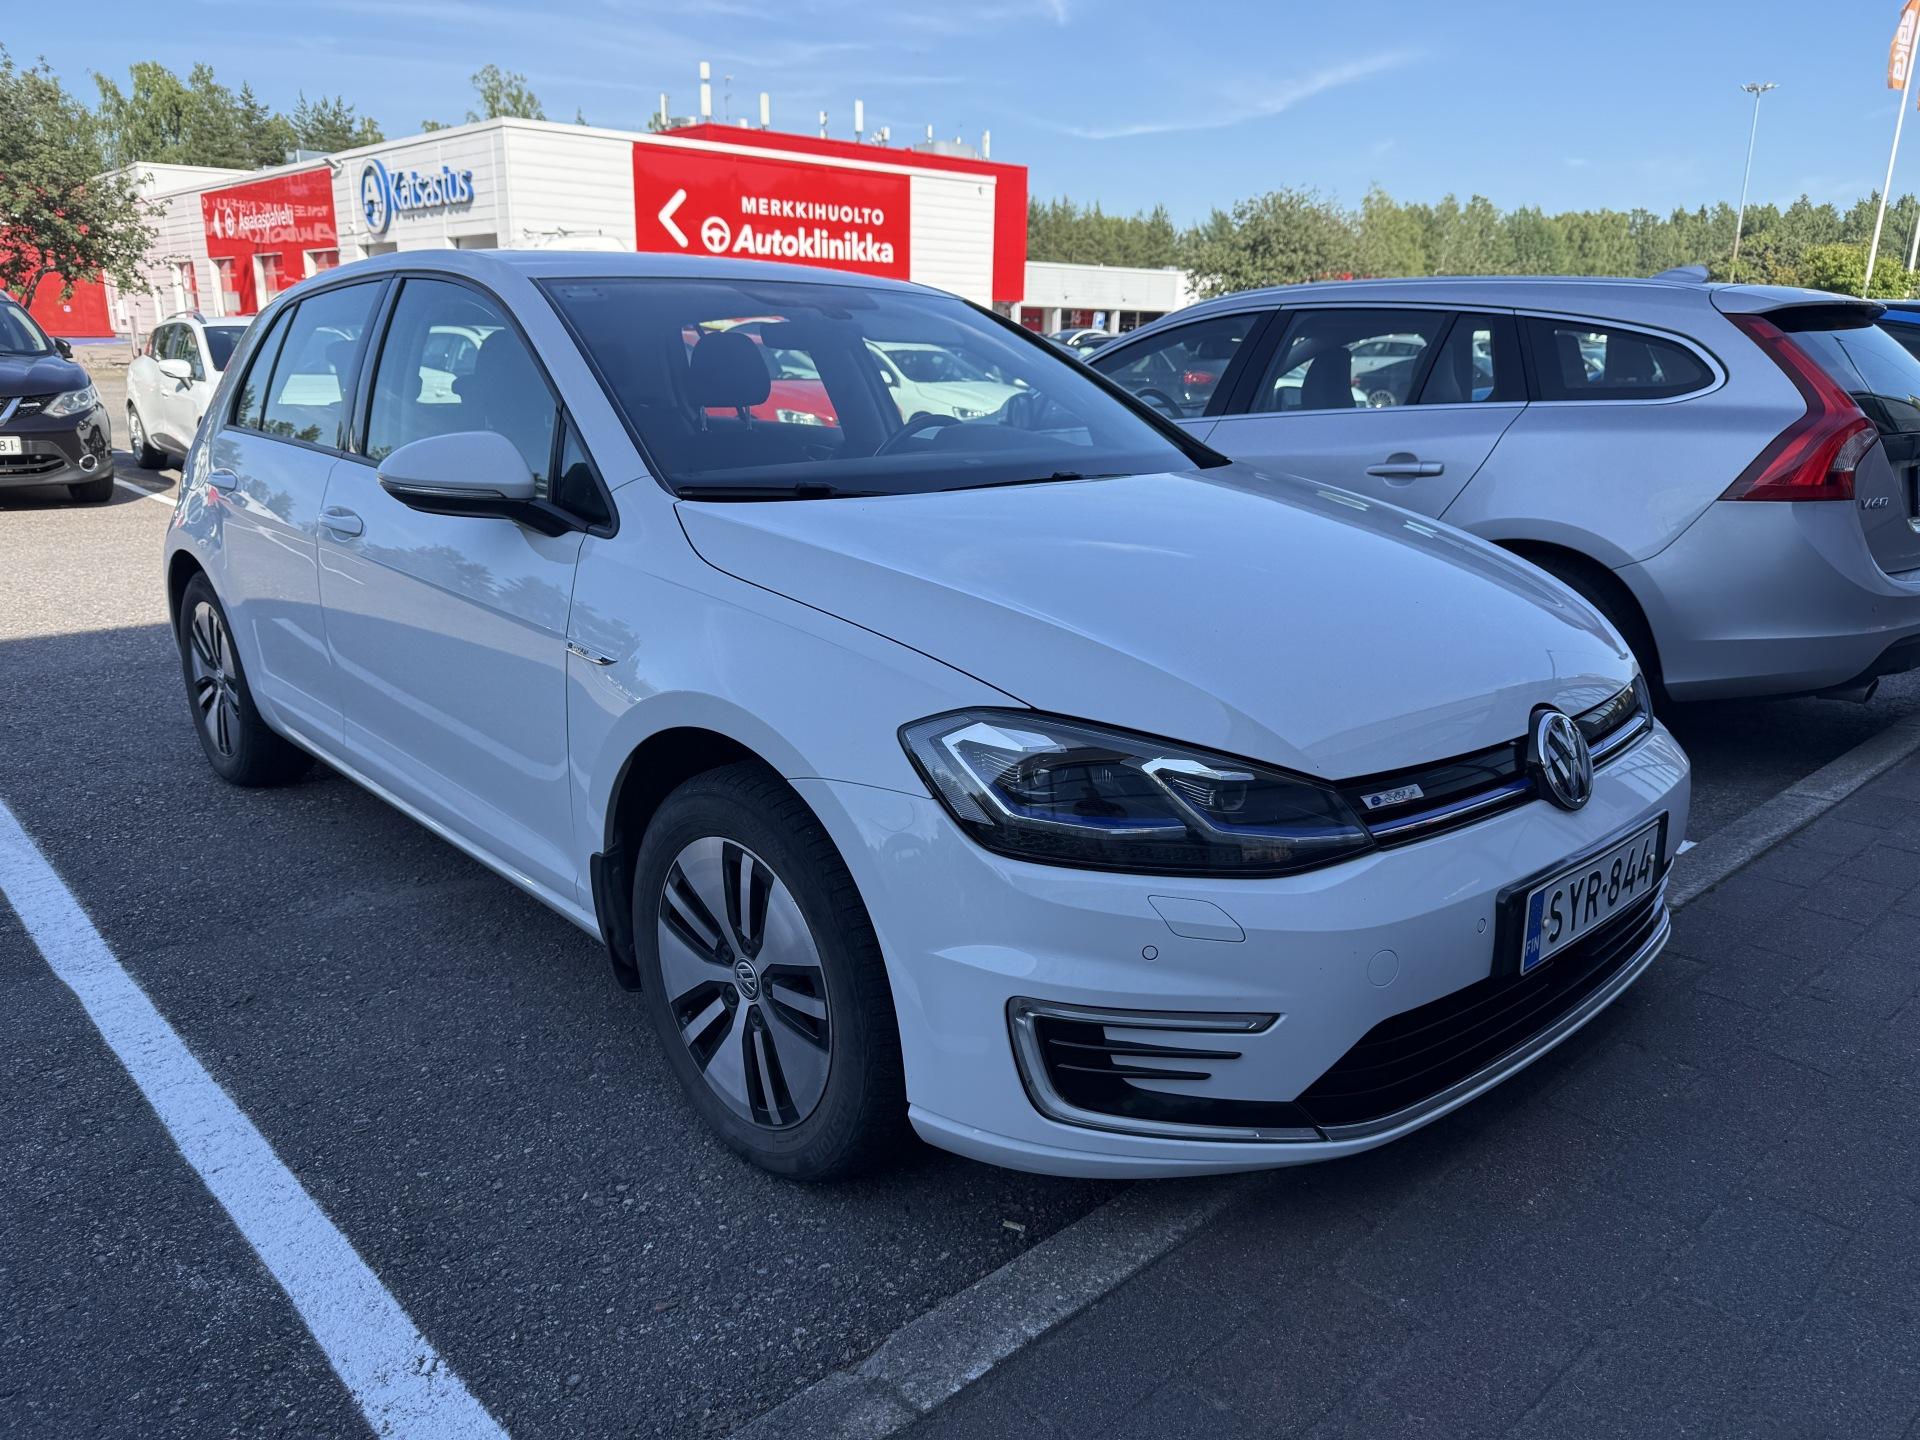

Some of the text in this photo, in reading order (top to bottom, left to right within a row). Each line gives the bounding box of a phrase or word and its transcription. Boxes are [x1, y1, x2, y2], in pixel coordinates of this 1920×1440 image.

[387, 166, 474, 210] Katsastus
[741, 196, 885, 226] MERKKIHUOLTO
[731, 223, 895, 264] Autoklinikka
[1549, 838, 1651, 943] SYR-844
[1525, 934, 1541, 957] FIN
